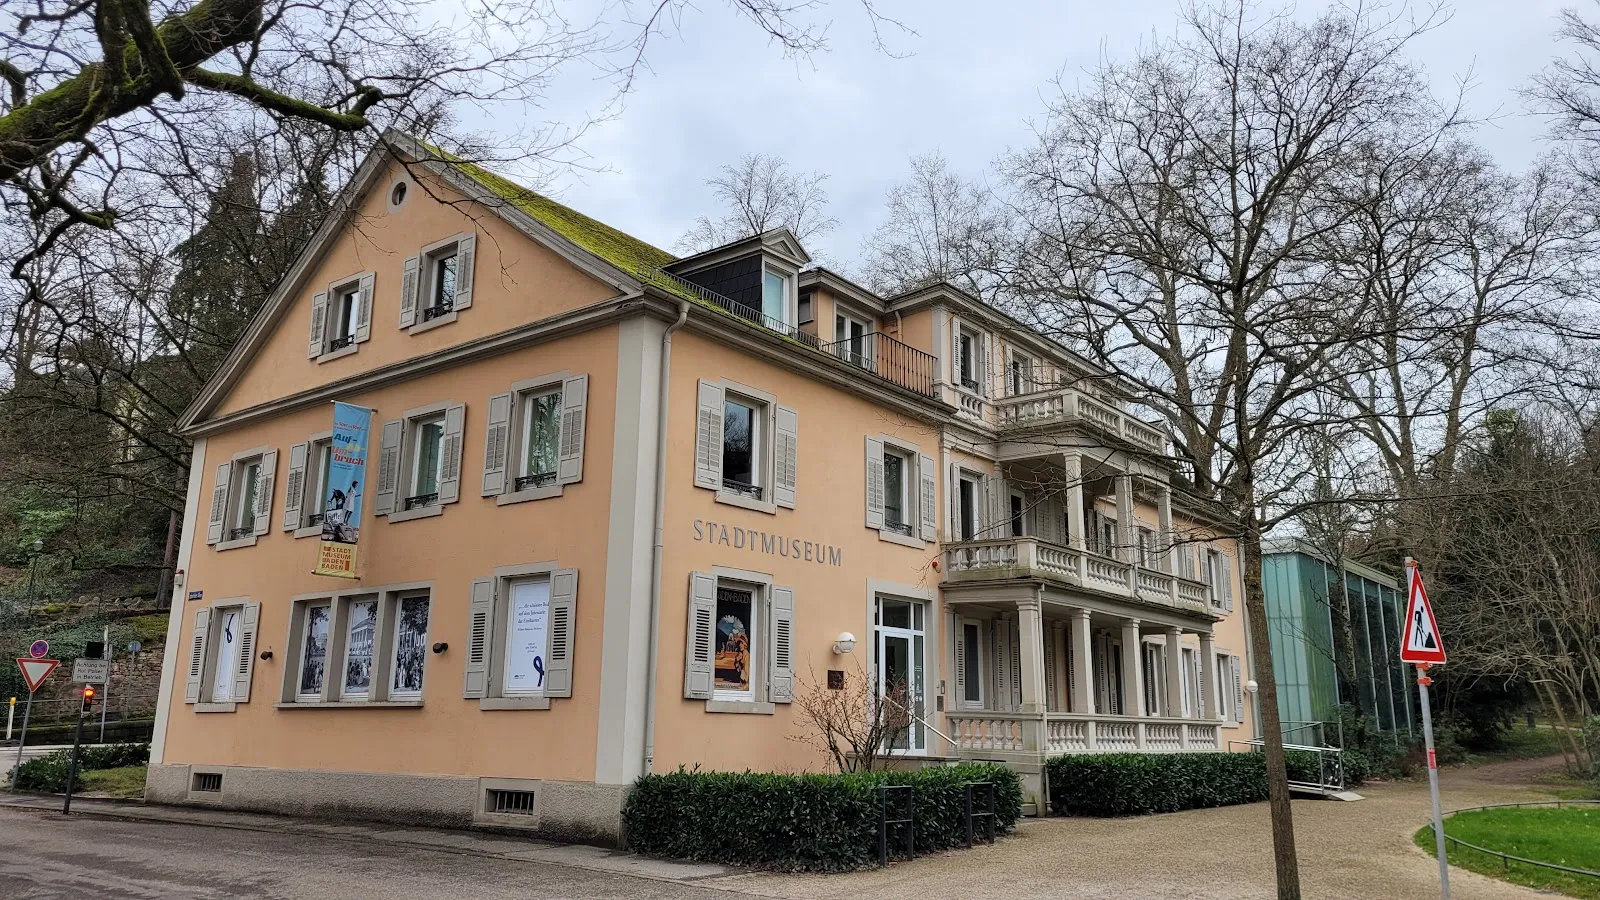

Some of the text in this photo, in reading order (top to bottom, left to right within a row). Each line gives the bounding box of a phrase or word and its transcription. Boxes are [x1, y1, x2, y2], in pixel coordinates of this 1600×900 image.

[333, 433, 358, 444] Auf-
[334, 453, 364, 466] bruch
[693, 518, 842, 567] STADTMUSEUM
[332, 546, 352, 554] STADT
[322, 551, 352, 560] MUSEUM
[321, 557, 345, 565] BADEN
[321, 563, 344, 571] BADEN
